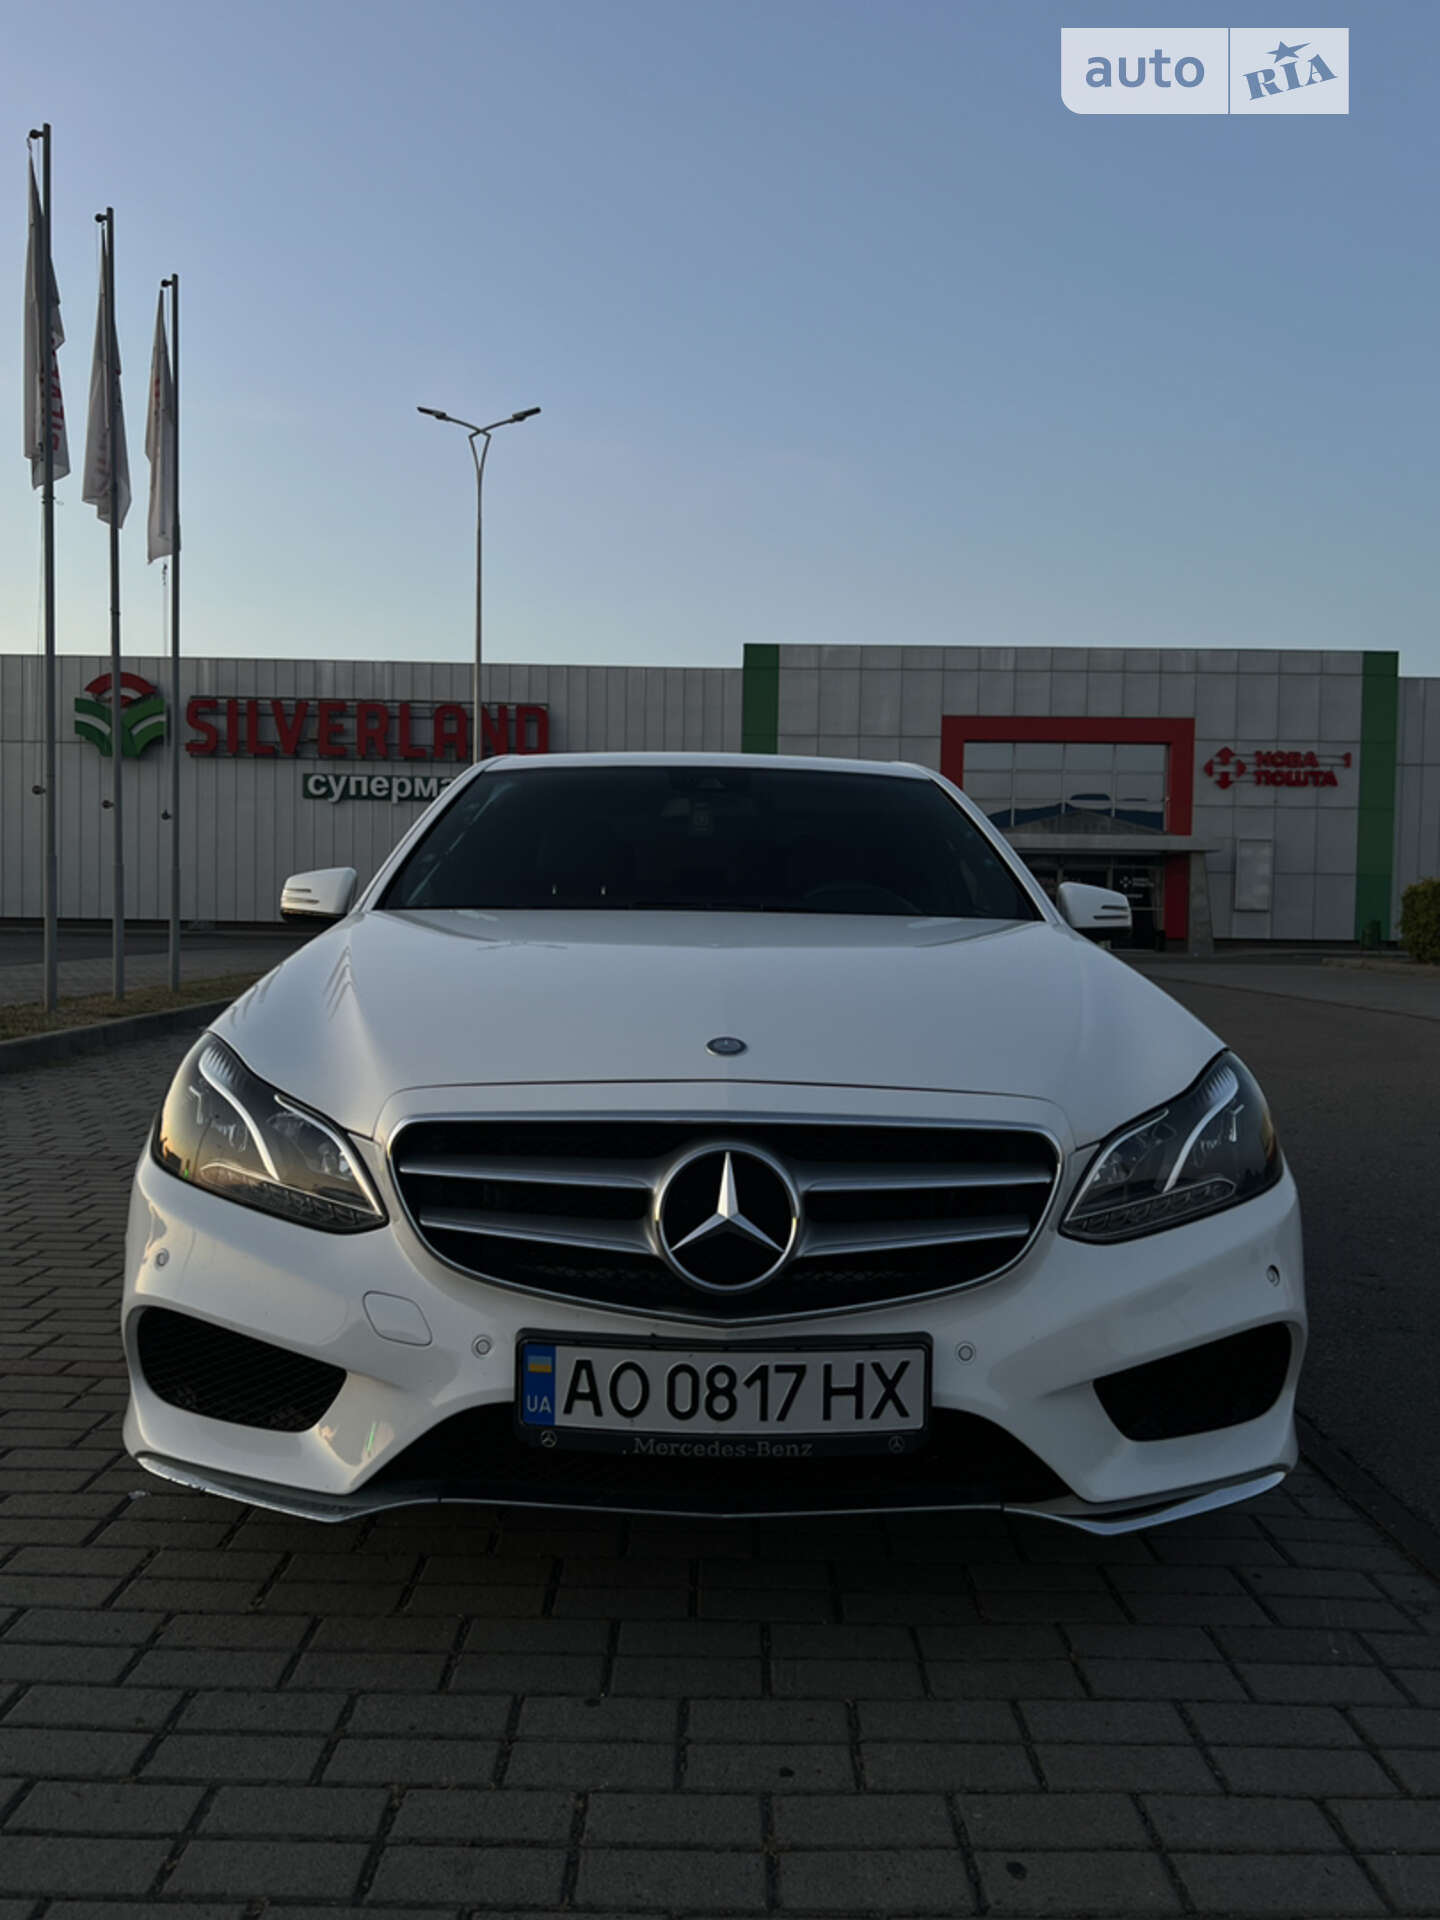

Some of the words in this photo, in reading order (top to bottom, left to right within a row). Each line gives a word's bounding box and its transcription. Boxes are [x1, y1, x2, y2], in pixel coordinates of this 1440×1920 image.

[186, 698, 549, 758] SILVERLAND
[1255, 751, 1319, 768] НОВА
[1254, 770, 1338, 787] ПОШТА
[563, 1359, 650, 1419] AO
[666, 1363, 807, 1422] 0817
[822, 1360, 911, 1421] HX
[526, 1395, 552, 1414] UA
[634, 1437, 813, 1457] Mercedes-Benz
